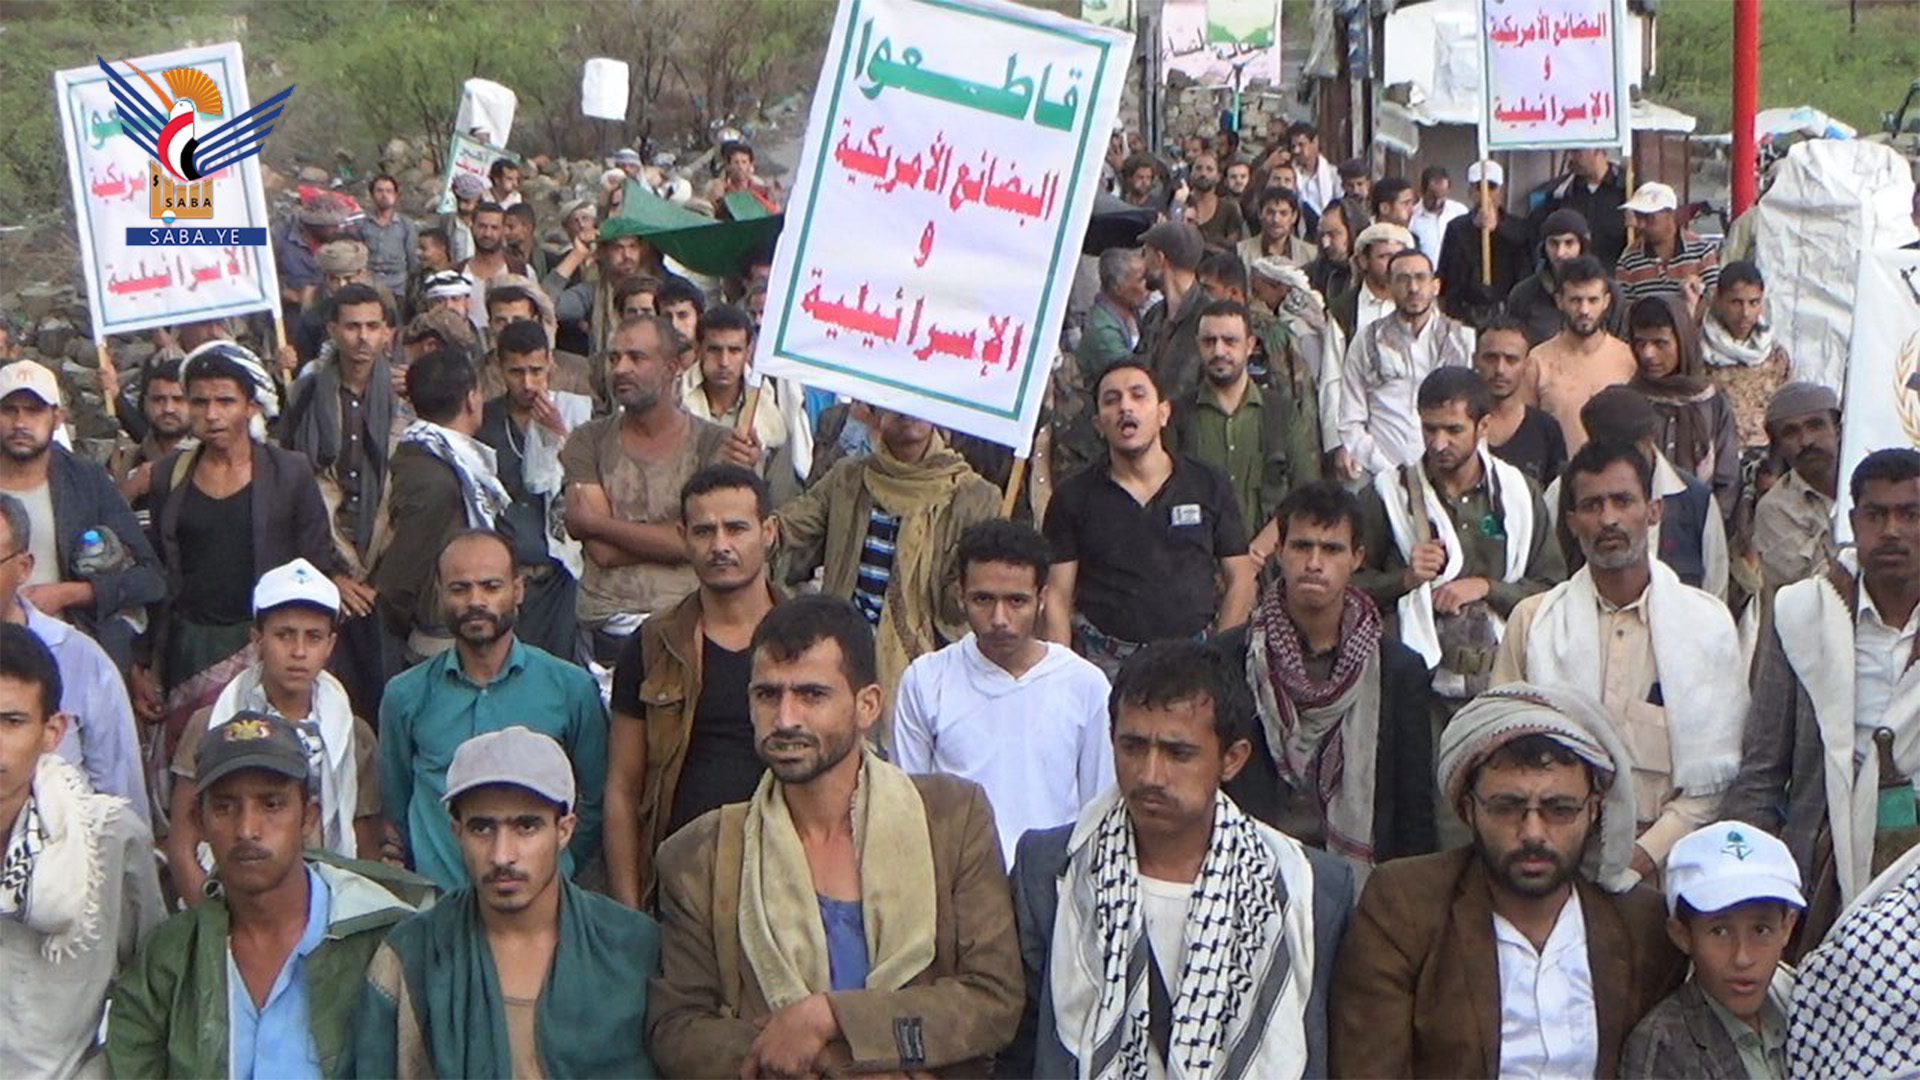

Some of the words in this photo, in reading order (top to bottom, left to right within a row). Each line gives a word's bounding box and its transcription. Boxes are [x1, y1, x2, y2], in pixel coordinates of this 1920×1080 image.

[1489, 8, 1550, 48] الأمريكية
[1552, 11, 1606, 47] البضائع
[854, 16, 1082, 132] قاطعوا
[1544, 55, 1551, 81] و
[1494, 91, 1610, 128] الإسرائيلية
[834, 118, 953, 194] الأمريكية
[949, 149, 1059, 226] البضائع
[914, 220, 936, 267] و
[801, 268, 1024, 377] الإسرائيلية
